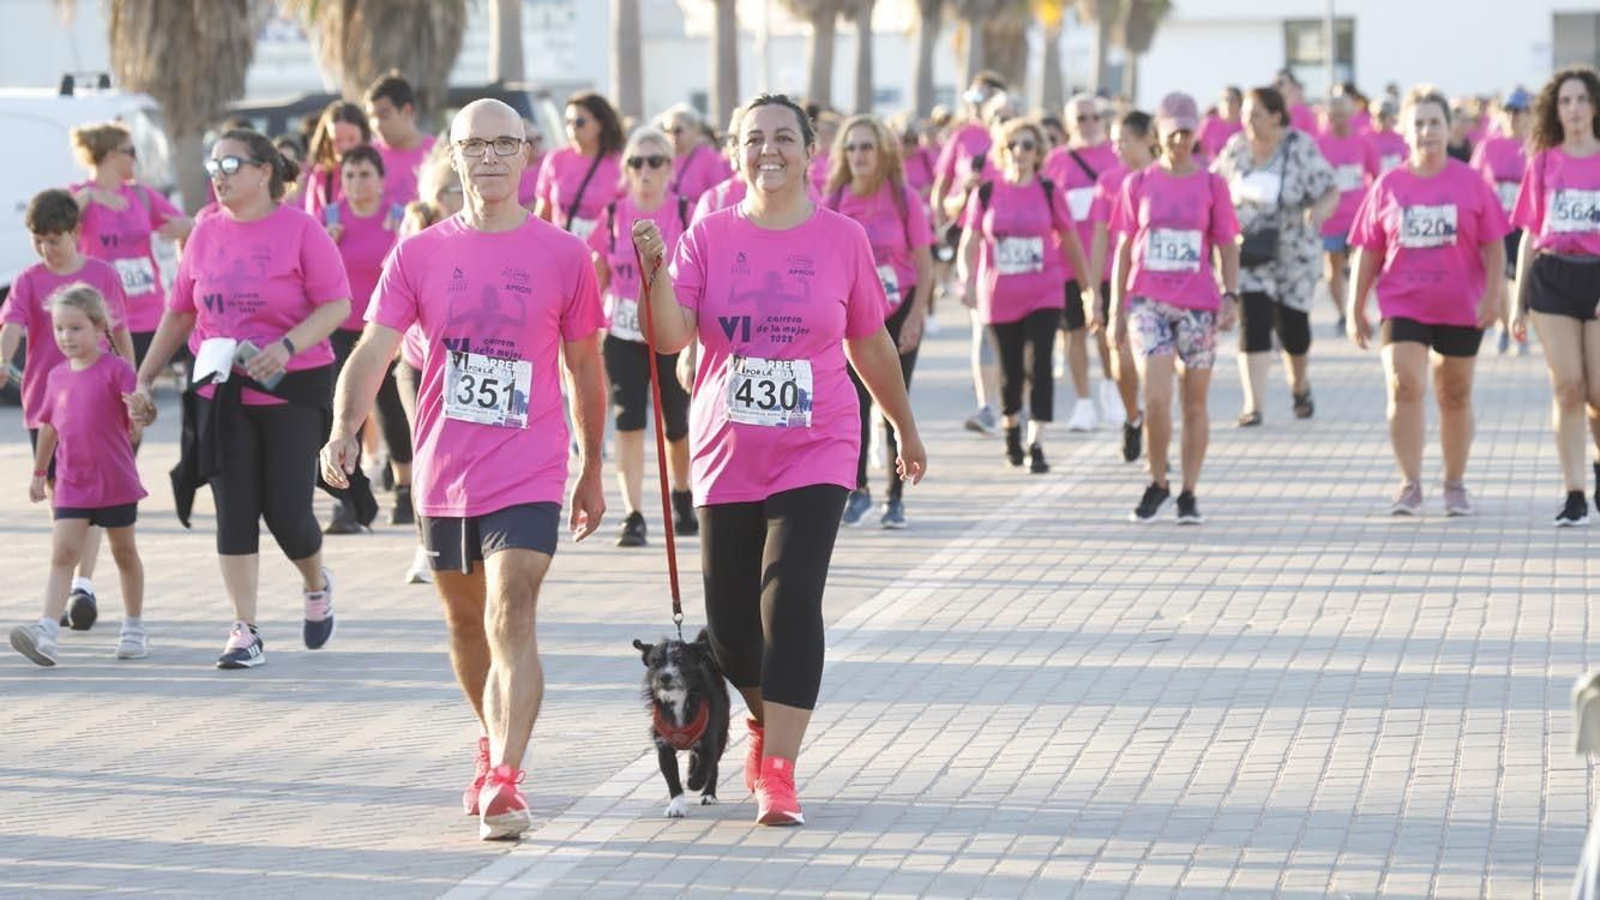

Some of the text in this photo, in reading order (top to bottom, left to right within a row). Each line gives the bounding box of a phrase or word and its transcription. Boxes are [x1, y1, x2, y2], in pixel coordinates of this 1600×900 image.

[1557, 201, 1596, 221] 564
[1408, 218, 1446, 237] 520
[1151, 243, 1190, 260] 192
[203, 293, 224, 314] VI
[718, 316, 752, 342] VI
[766, 316, 803, 324] carrera
[756, 325, 811, 336] de la mujer
[482, 338, 516, 348] carrera
[496, 349, 523, 361] mujer
[457, 374, 516, 412] 351
[735, 378, 798, 411] 430
